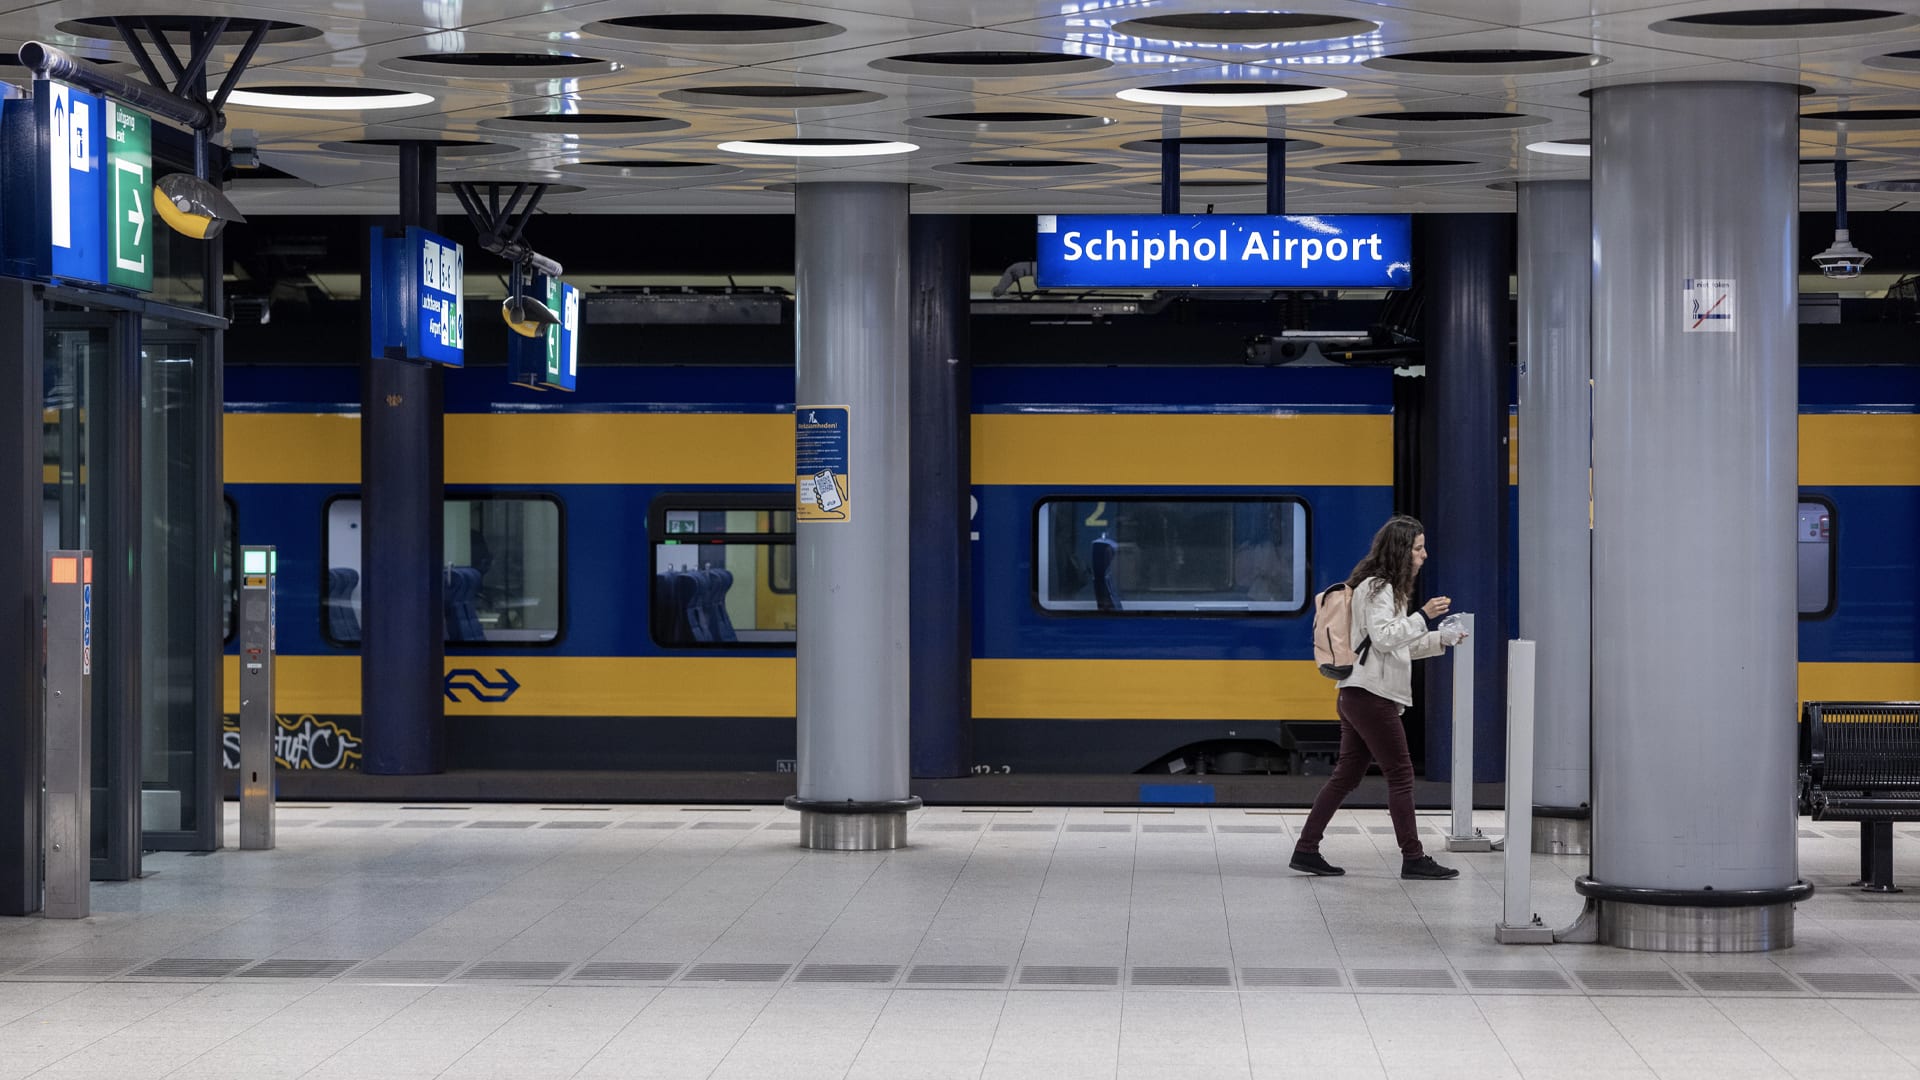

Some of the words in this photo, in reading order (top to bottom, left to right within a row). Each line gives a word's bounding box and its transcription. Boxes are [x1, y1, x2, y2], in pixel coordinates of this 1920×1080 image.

[117, 109, 135, 131] uitgang
[117, 129, 125, 143] exit
[1063, 229, 1227, 268] Schiphol
[1241, 230, 1383, 268] Airport
[424, 256, 434, 283] 1-2
